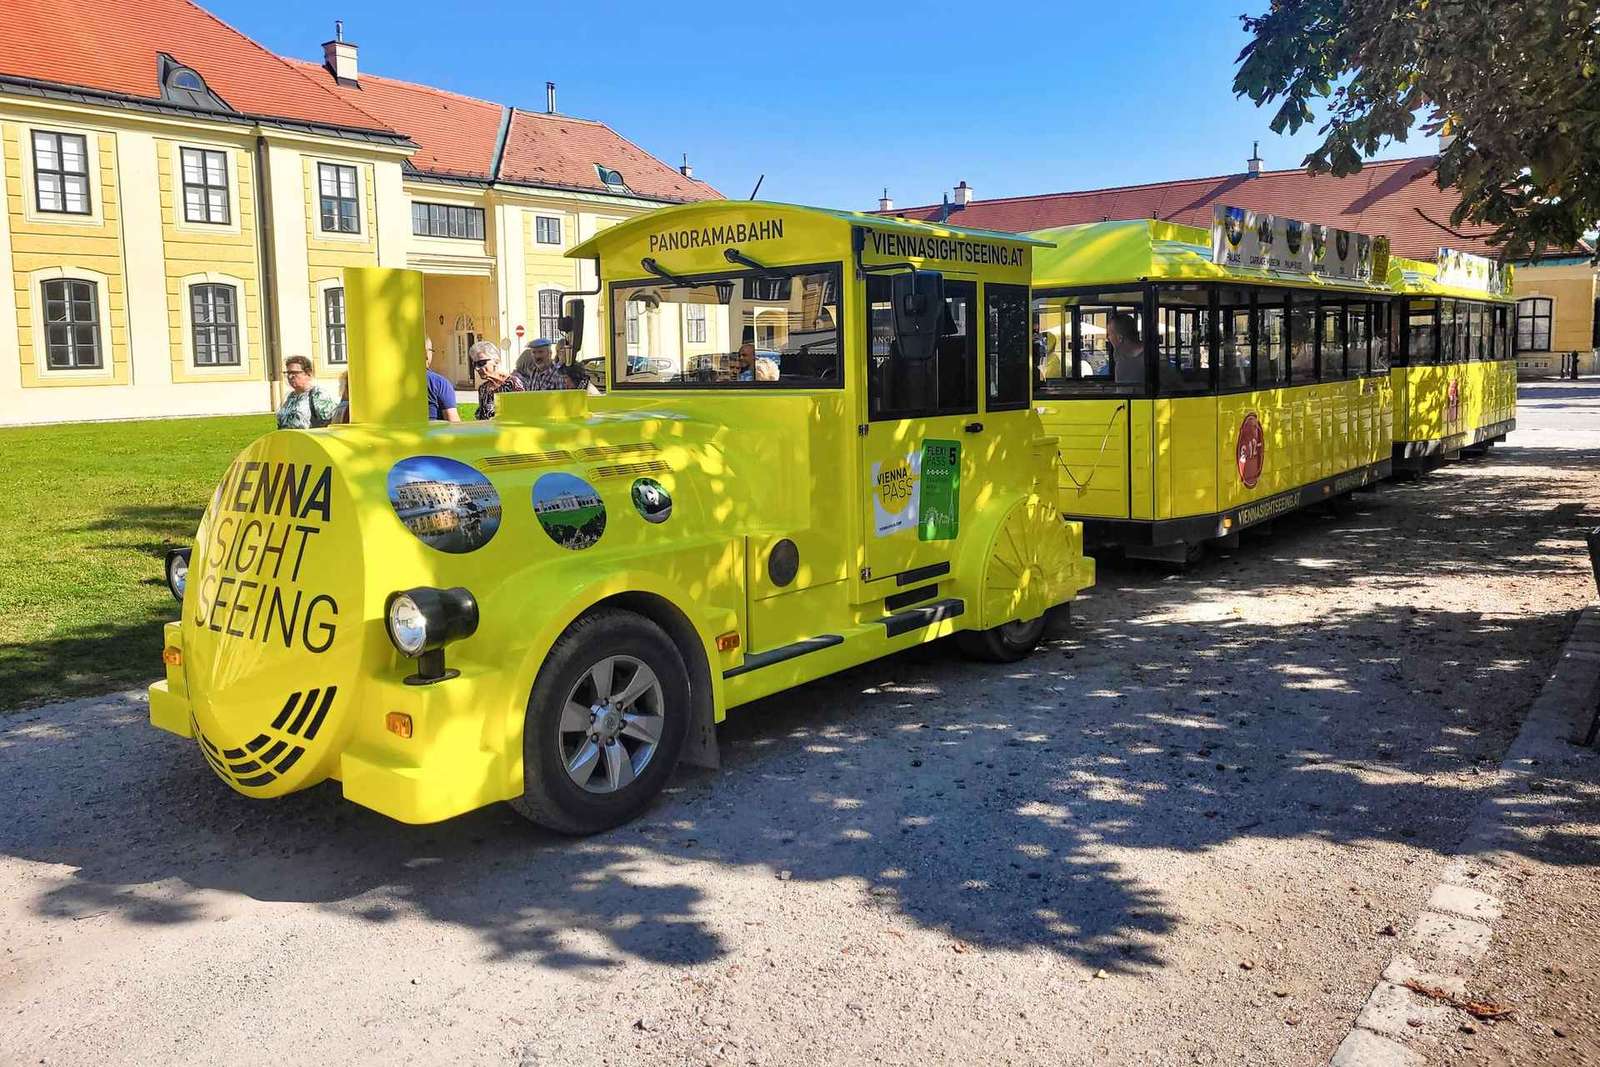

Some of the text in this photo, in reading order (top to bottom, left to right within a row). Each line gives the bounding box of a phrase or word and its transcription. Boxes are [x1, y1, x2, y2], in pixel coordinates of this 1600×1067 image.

[649, 218, 784, 254] PANORAMABAHN
[872, 232, 1024, 268] VIENNASIGHTSEEING.AT
[948, 447, 957, 465] 5
[877, 466, 908, 485] VIENNA
[882, 477, 913, 503] PASS
[209, 517, 320, 582] SIGHT
[195, 574, 339, 653] SEEING
